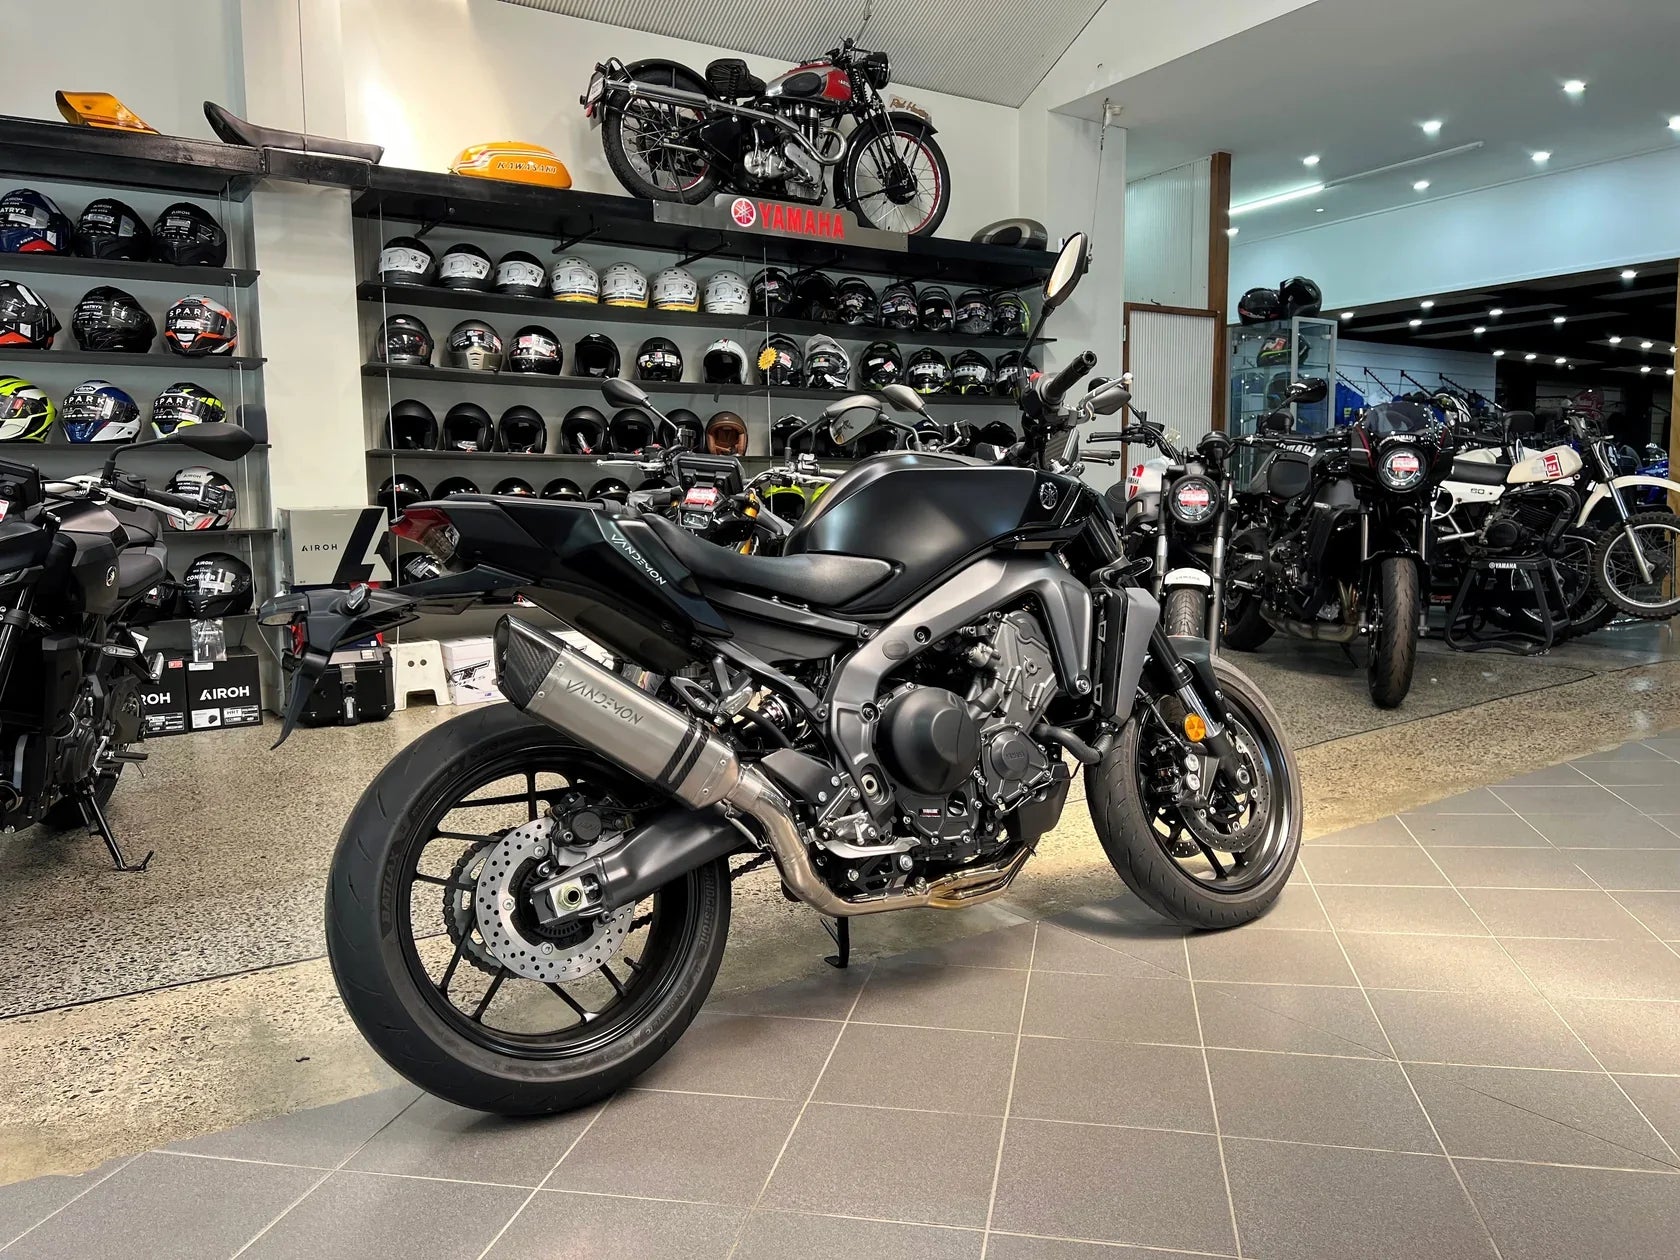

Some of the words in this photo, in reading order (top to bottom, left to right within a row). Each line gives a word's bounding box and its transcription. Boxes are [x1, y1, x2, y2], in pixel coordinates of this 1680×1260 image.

[497, 161, 557, 174] KAWASAKI
[758, 201, 845, 239] YAMAHA
[169, 307, 212, 319] SPARK
[63, 395, 106, 406] SPARK
[154, 397, 194, 407] SPARK
[301, 543, 338, 552] AIROH
[611, 534, 667, 585] VANDEMON
[1495, 562, 1517, 570] YAMAHA
[199, 685, 250, 701] AIROH
[566, 679, 644, 725] VANDEMON
